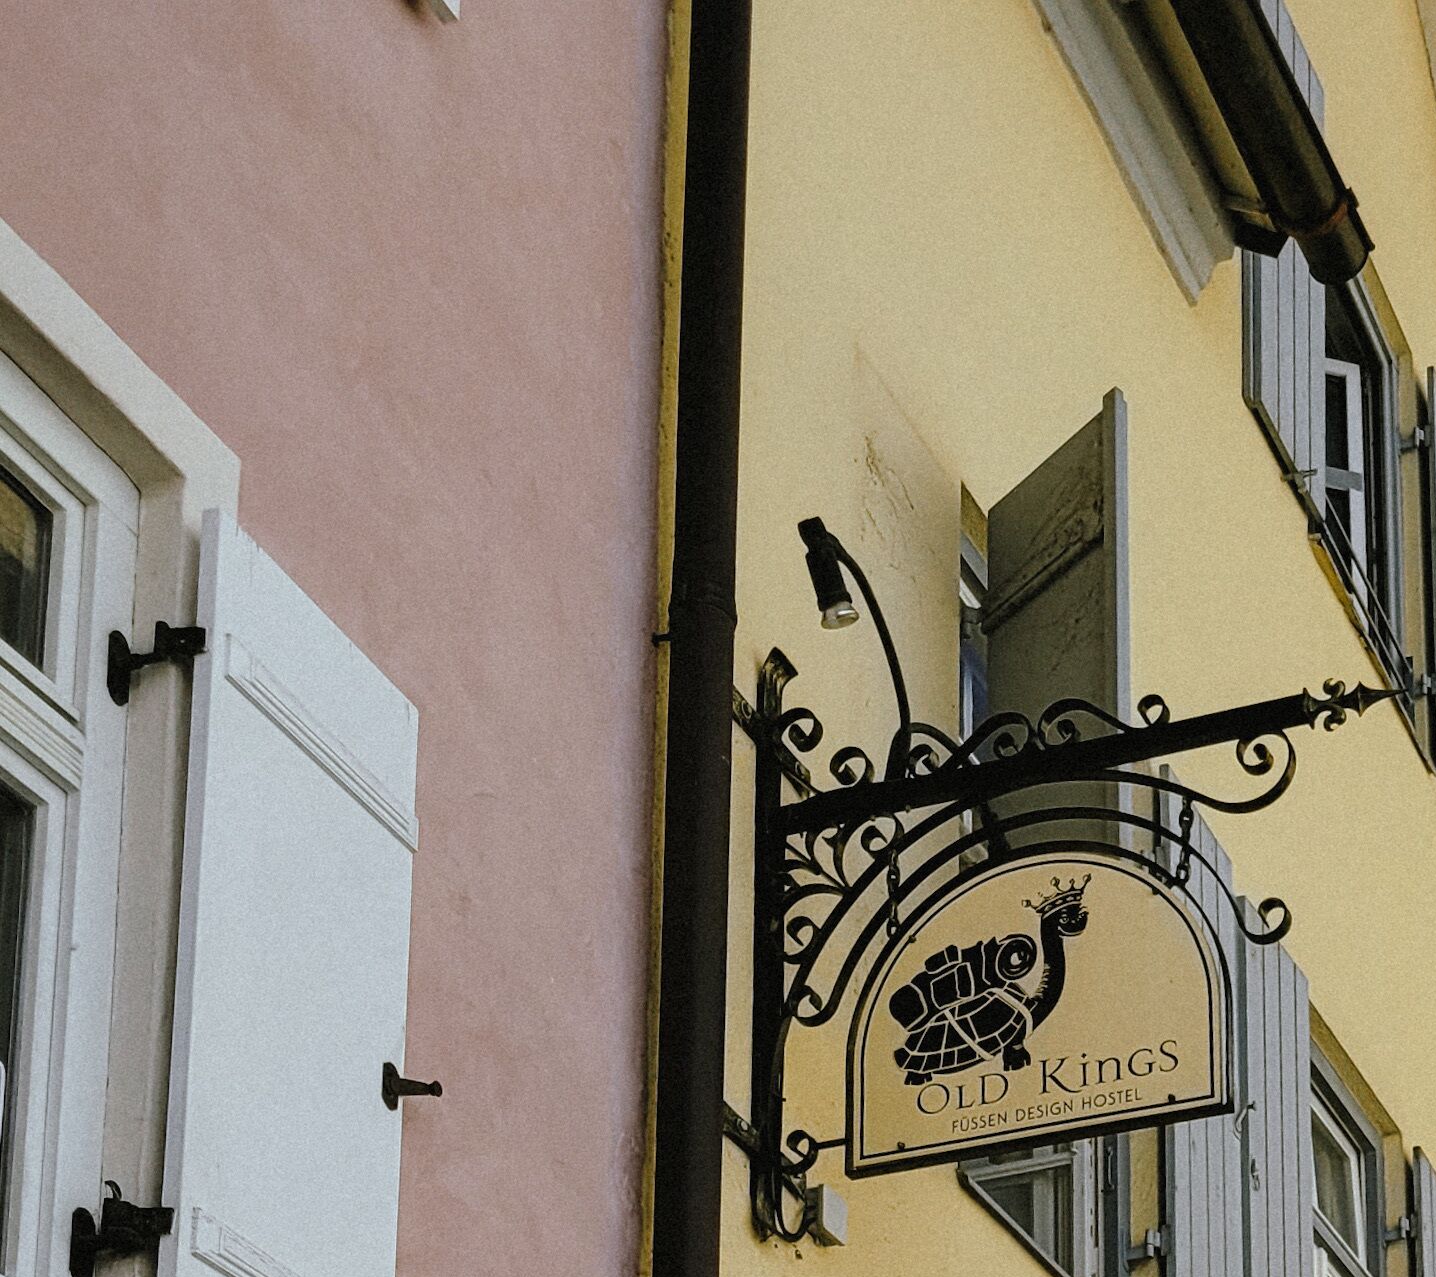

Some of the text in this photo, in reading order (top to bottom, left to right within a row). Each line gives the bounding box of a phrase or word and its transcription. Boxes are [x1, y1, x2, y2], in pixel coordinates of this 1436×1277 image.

[917, 1074, 1009, 1115] OLD
[951, 1088, 1143, 1134] FÜSSEN DESIGN HOSTEL
